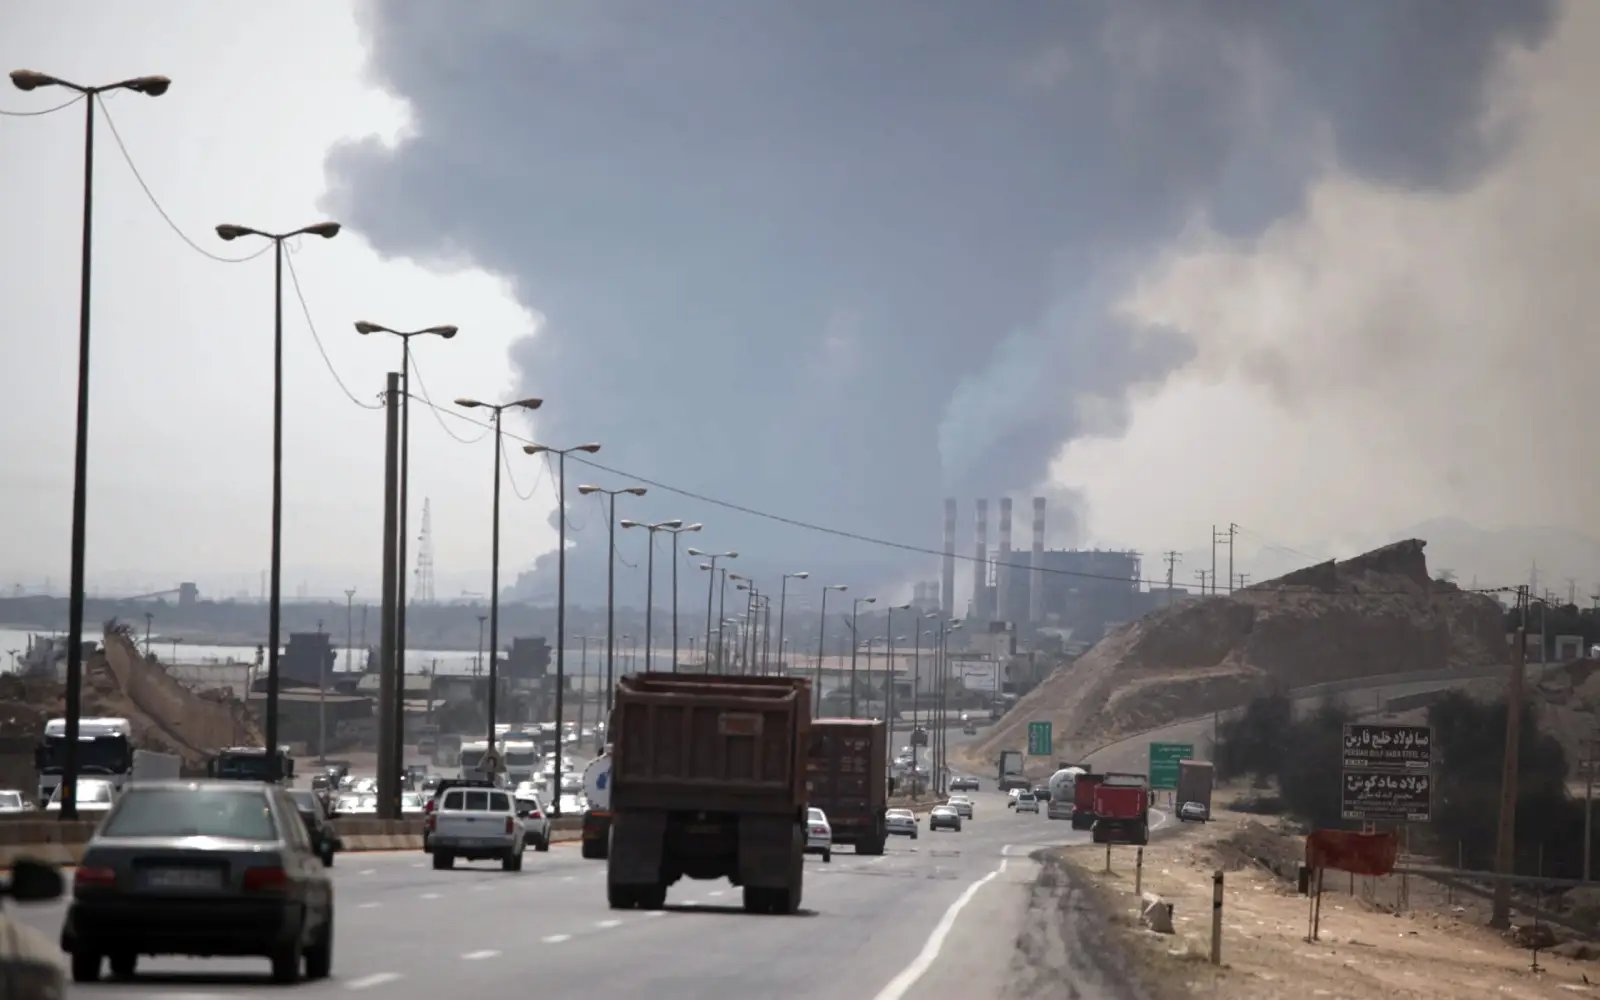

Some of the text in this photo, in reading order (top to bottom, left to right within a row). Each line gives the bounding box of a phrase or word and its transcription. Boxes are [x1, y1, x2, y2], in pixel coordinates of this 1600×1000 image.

[1346, 729, 1370, 747] فارس
[1393, 730, 1413, 749] فولاد
[1399, 777, 1428, 793] فولاد
